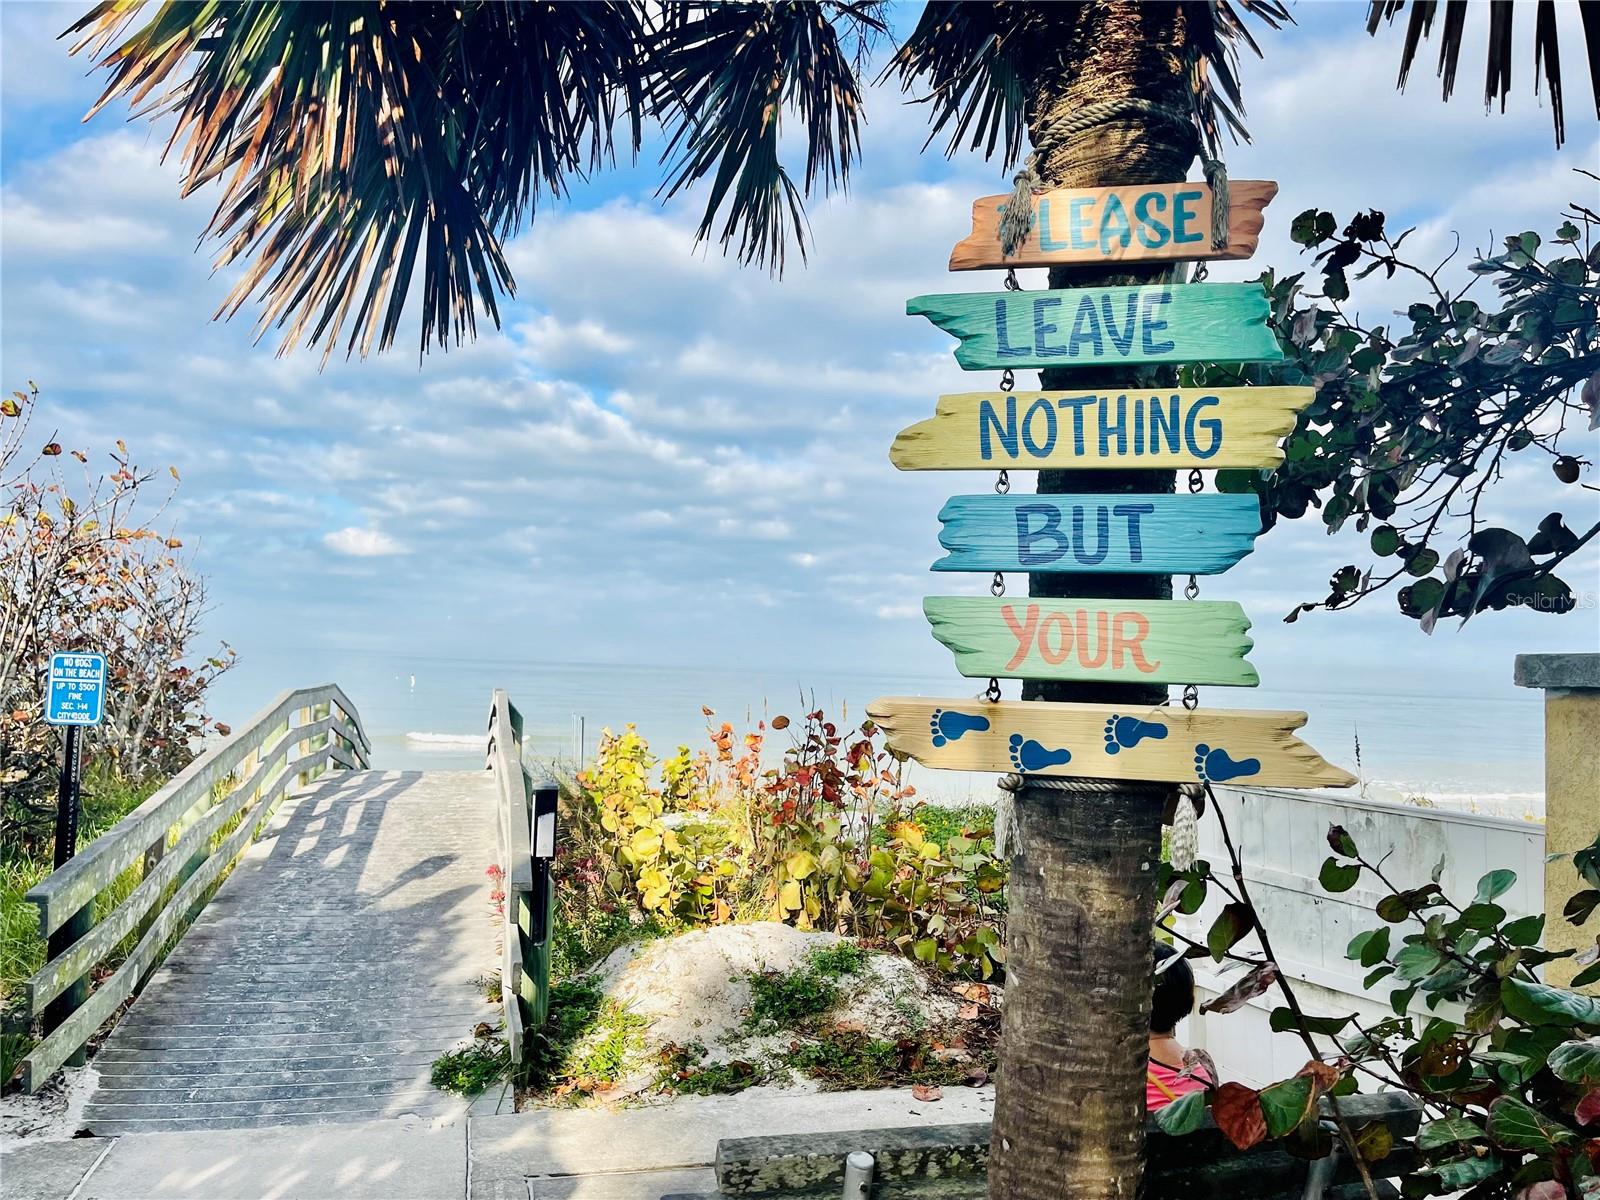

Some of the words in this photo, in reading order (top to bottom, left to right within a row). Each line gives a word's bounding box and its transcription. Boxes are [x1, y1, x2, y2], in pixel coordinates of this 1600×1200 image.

[995, 291, 1176, 359] LEAVE
[979, 394, 1222, 461] NOTHING
[1015, 503, 1154, 565] BUT
[1000, 604, 1161, 674] YOUR
[64, 658, 74, 667] NO
[54, 668, 64, 677] ON
[65, 668, 77, 677] THE
[79, 669, 100, 678] BEACH
[56, 682, 65, 690] UP
[78, 683, 96, 691] $500
[68, 692, 82, 700] FINE
[57, 711, 71, 720] CITY
